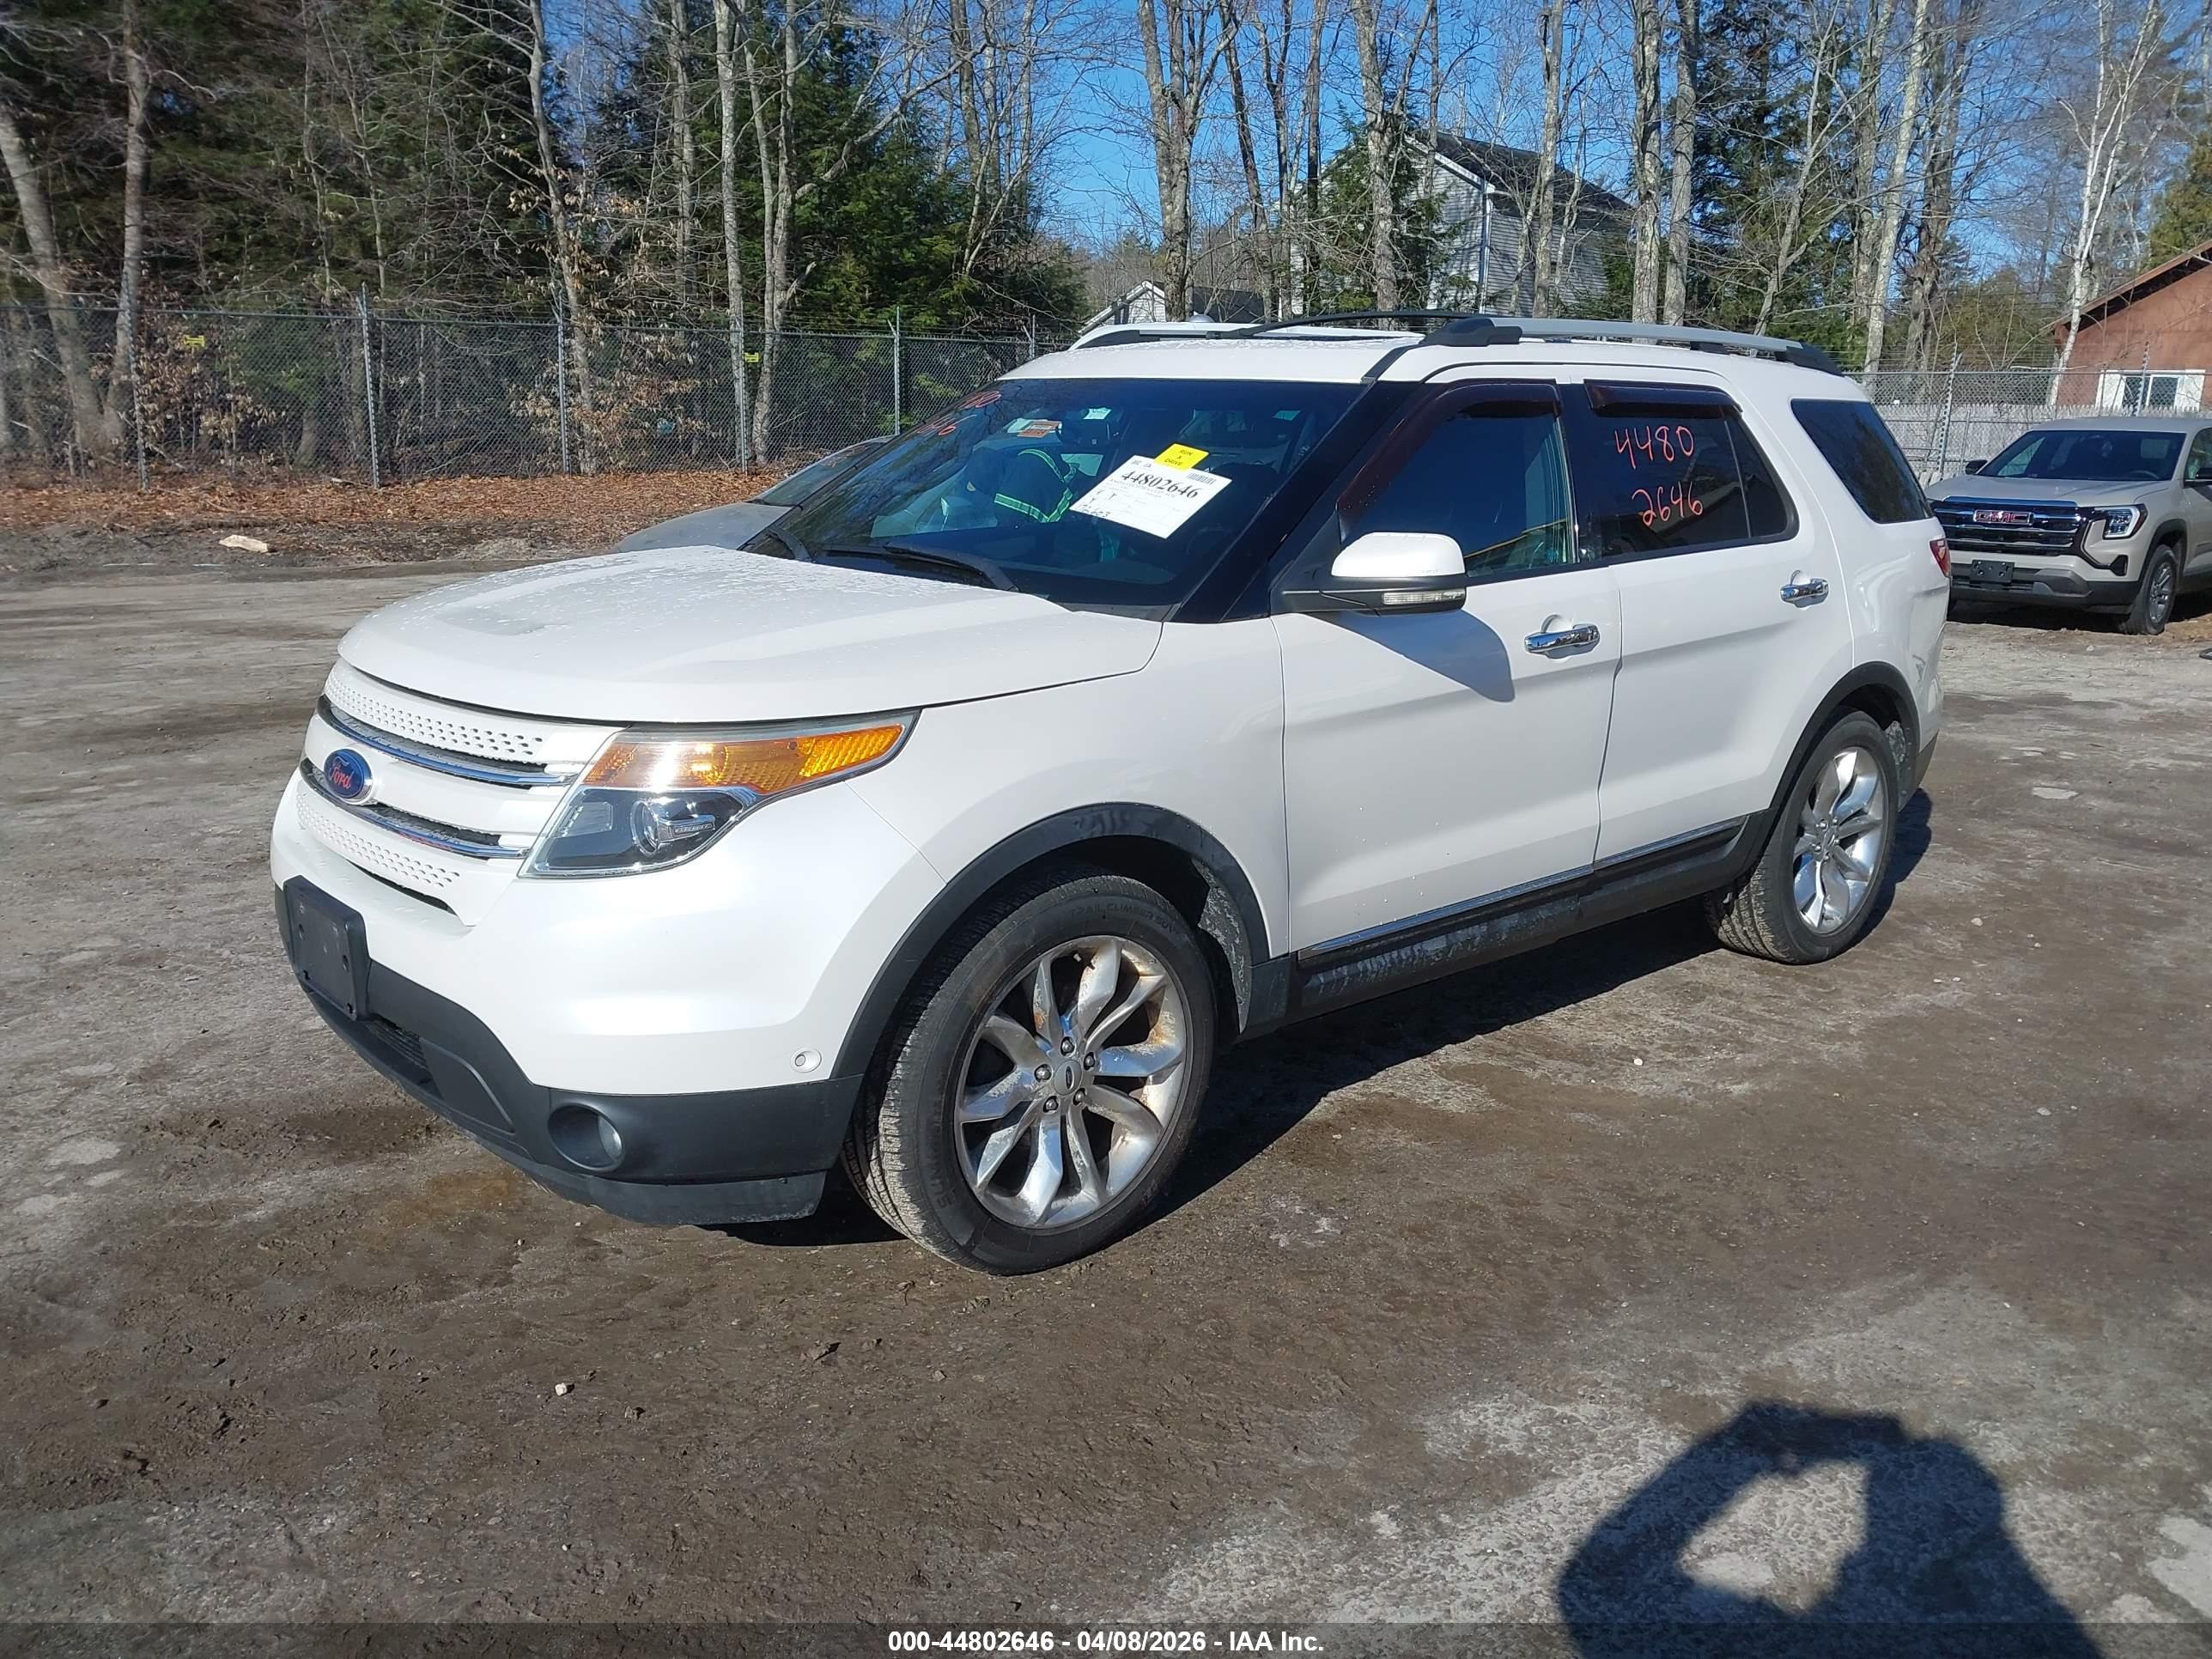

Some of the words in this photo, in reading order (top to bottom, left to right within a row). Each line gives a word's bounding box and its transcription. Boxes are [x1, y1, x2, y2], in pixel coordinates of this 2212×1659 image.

[1613, 425, 1694, 470] 4480
[1121, 471, 1202, 499] 44802646
[1632, 480, 1704, 527] 2646
[1977, 511, 2028, 523] GMC
[328, 756, 356, 790] Ford
